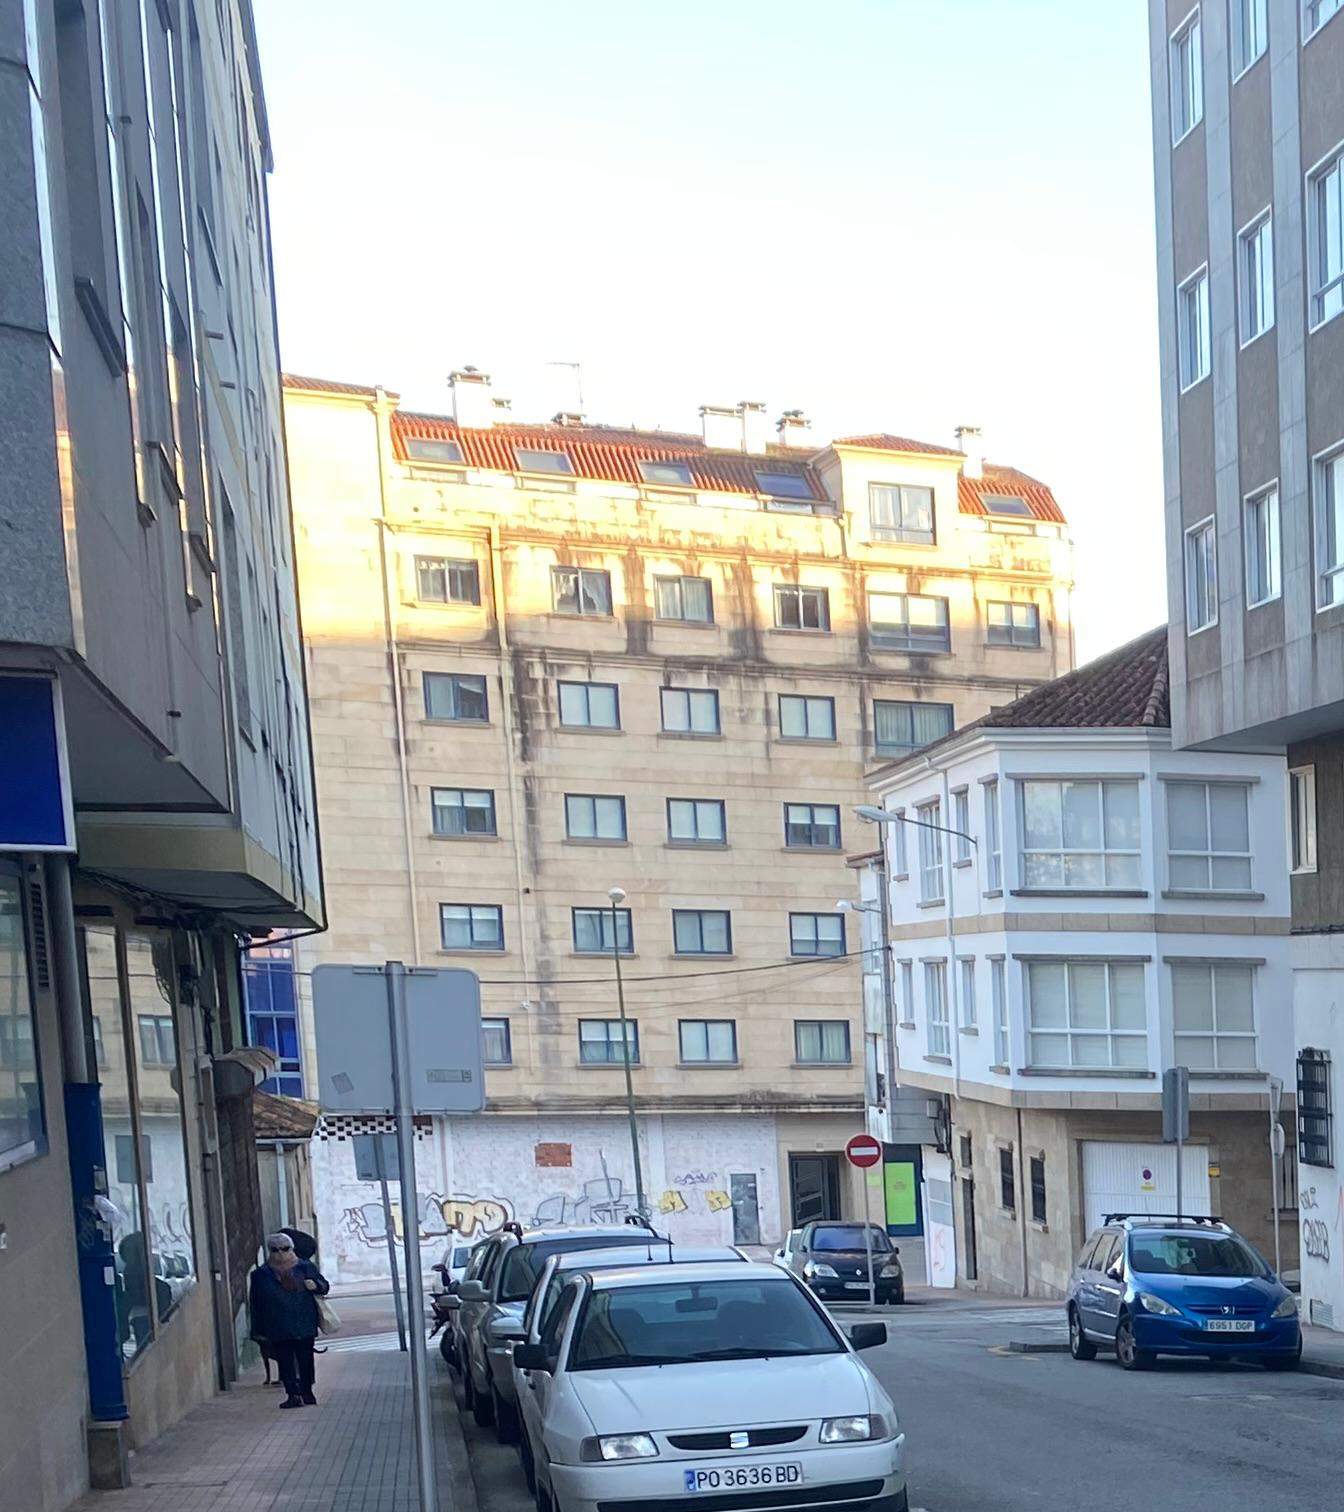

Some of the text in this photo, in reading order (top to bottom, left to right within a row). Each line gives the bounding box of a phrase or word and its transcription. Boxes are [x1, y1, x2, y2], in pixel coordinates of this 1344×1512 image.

[696, 1465, 800, 1489] PO 3636 BD
